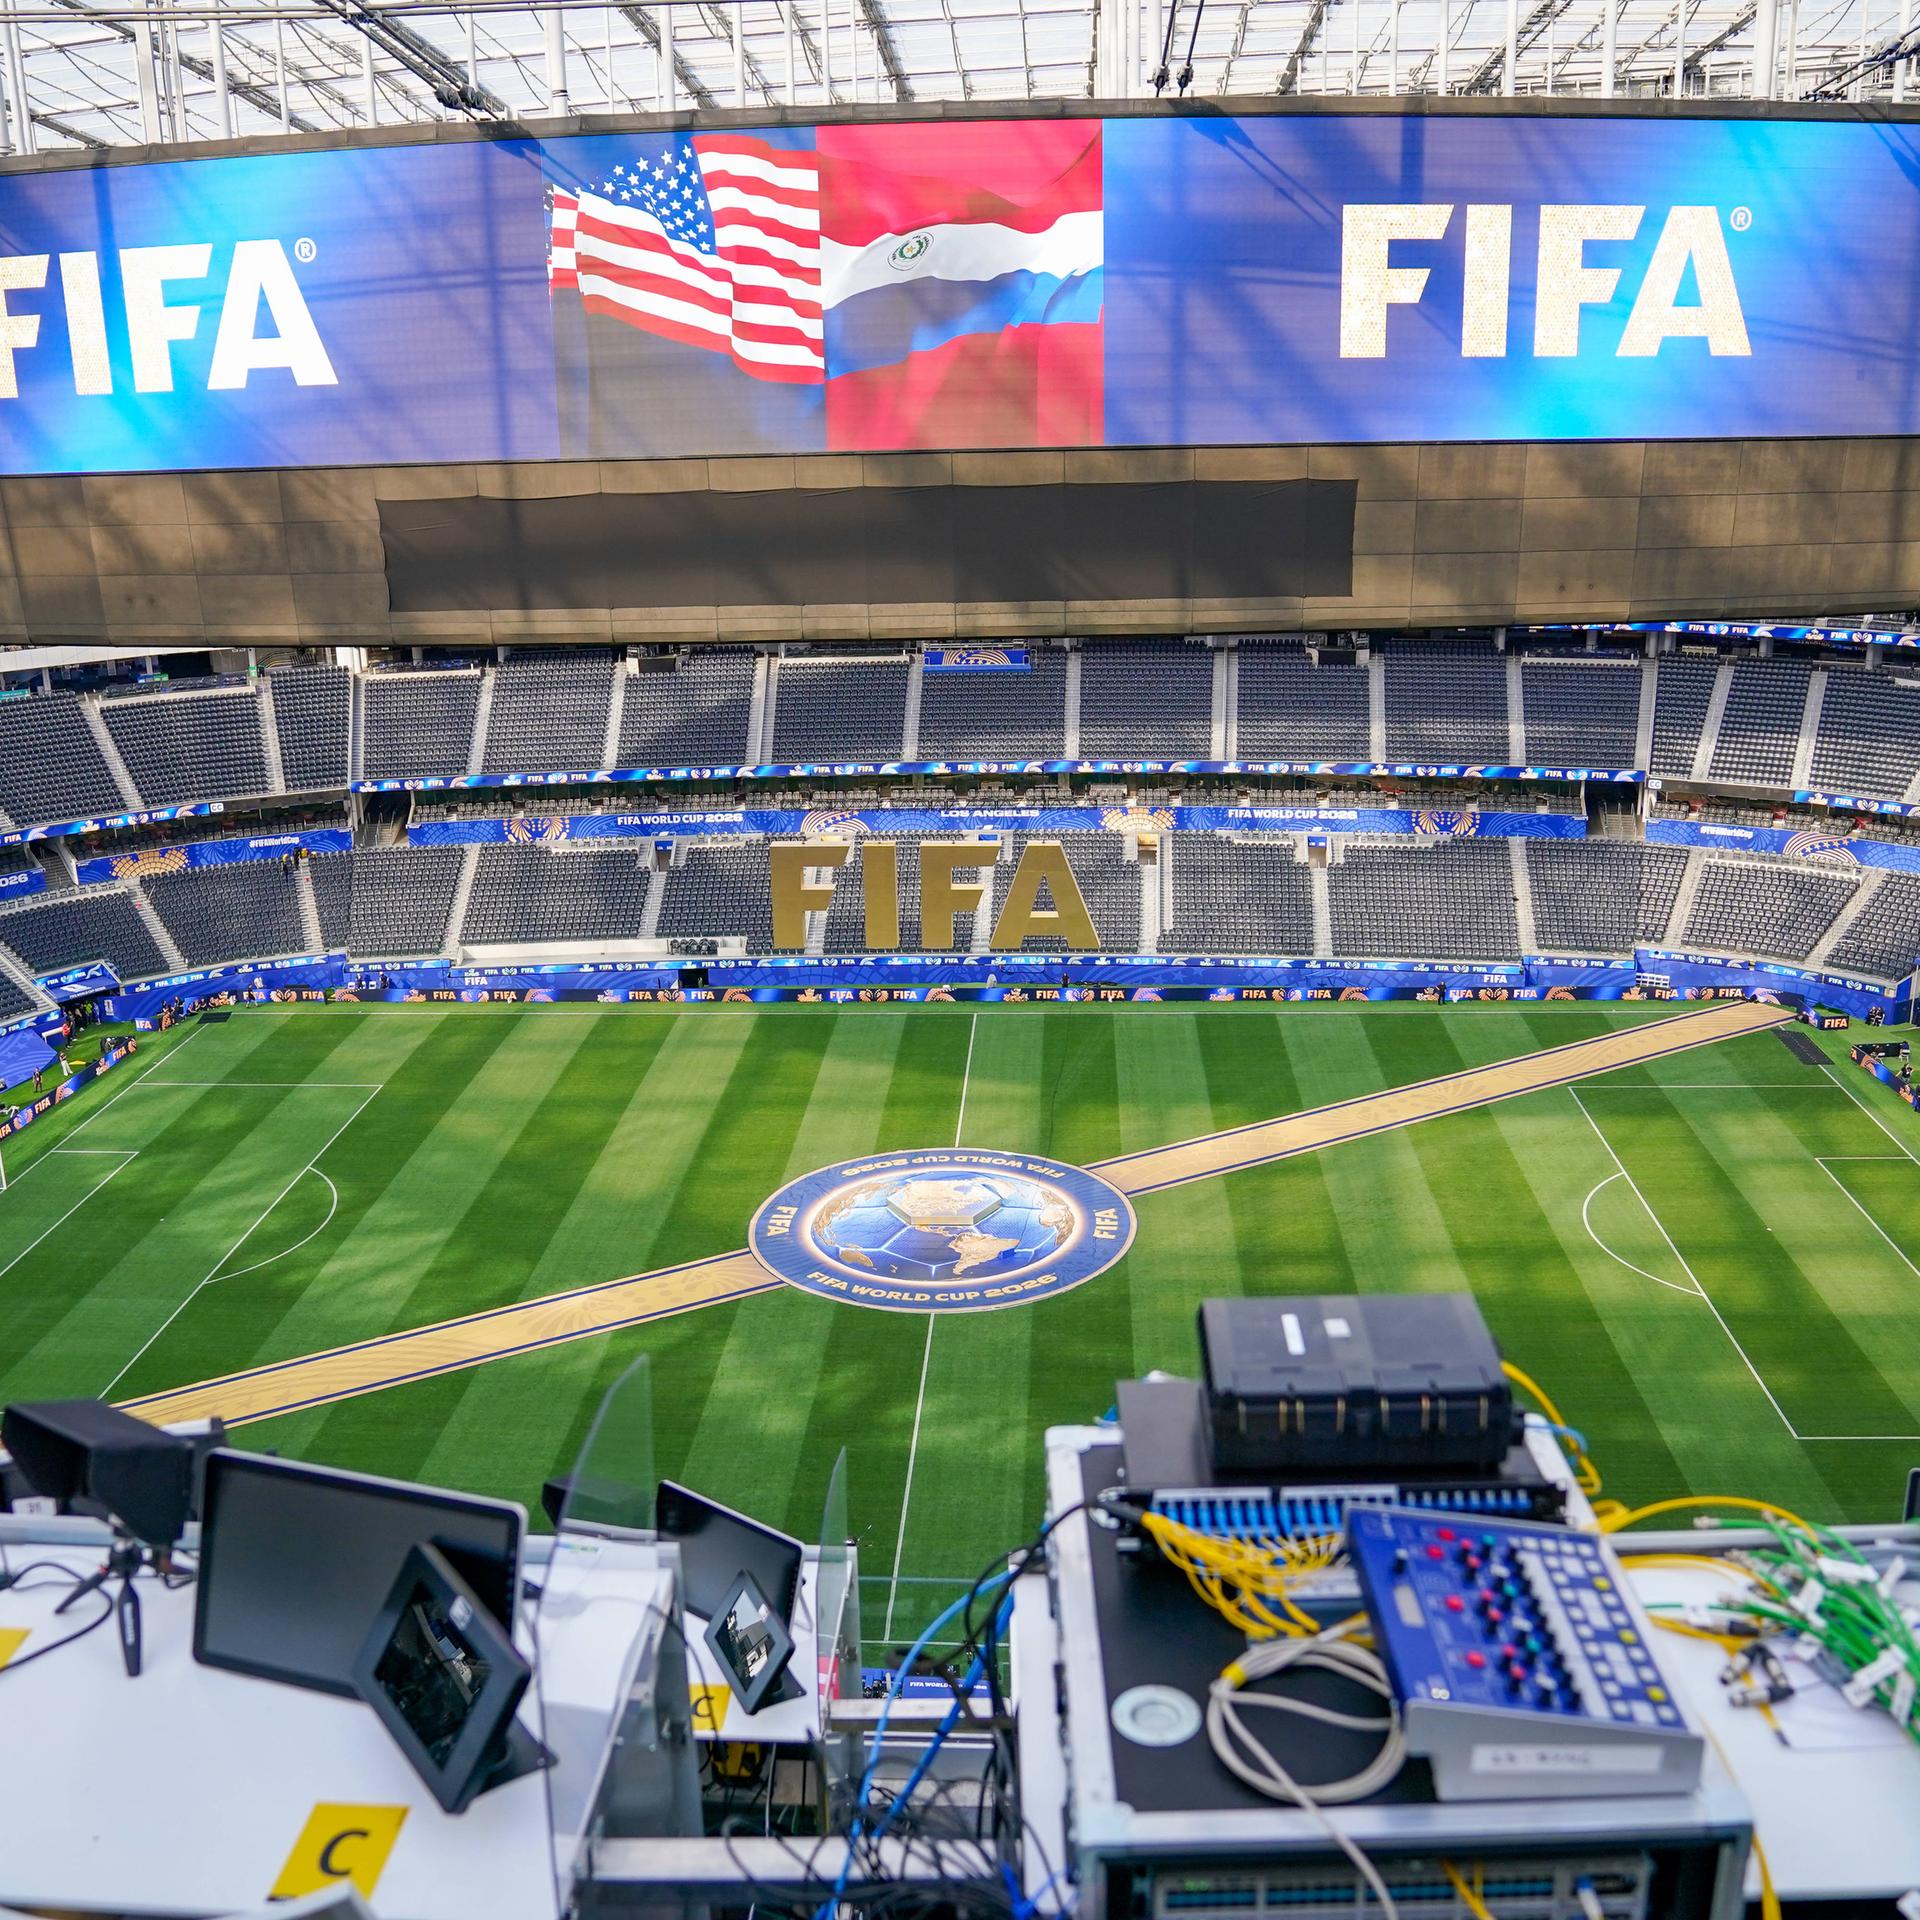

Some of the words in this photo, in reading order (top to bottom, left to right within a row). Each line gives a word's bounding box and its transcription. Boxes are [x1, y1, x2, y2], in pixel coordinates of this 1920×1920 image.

[1876, 635, 1892, 643] FIFA
[1545, 770, 1562, 778] FIFA
[1836, 798, 1853, 806] FIFA
[1884, 804, 1902, 813] FIFA
[1228, 809, 1251, 818] FIFA
[1254, 809, 1292, 819] WORLD
[1295, 810, 1317, 819] CUP
[1318, 810, 1358, 820] 2026
[106, 818, 123, 826] FIFA
[618, 815, 640, 825] FIFA
[642, 815, 681, 824] WORLD
[684, 814, 703, 823] CUP
[705, 814, 743, 823] 2026
[1700, 826, 1753, 839] #FIFAWorldCup
[4, 834, 21, 843] FIFA
[250, 837, 300, 848] #FIFAWorldCup
[770, 840, 1102, 949] FIFA
[465, 977, 487, 985] FIFA
[1484, 975, 1507, 983] FIFA
[1719, 989, 1742, 997] FIFA
[1866, 985, 1879, 993] FIFA
[243, 992, 265, 1000] FA
[434, 992, 456, 1000] FIFA
[494, 992, 516, 1000] FIFA
[629, 992, 652, 1000] FIFA
[691, 992, 714, 1000] FIFA
[830, 991, 853, 999] FIFA
[893, 991, 917, 999] FIFA
[1036, 991, 1059, 999] FIFA
[1101, 991, 1124, 999] FIFA
[1243, 990, 1266, 998] FIFA
[1307, 990, 1331, 998] FIFA
[1450, 990, 1473, 998] FIFA
[1514, 990, 1537, 998] FIFA
[1655, 989, 1678, 999] FIFA
[1825, 1018, 1848, 1028] FIFA
[9, 1024, 19, 1032] FIFA
[113, 1047, 126, 1061] FIFA
[35, 1098, 50, 1114] FIFA
[912, 1155, 950, 1163] CUP
[954, 1155, 1024, 1168] WORLD
[841, 1158, 909, 1177] 2026
[1027, 1163, 1066, 1178] FIFA
[768, 1206, 799, 1236] FIFA
[1093, 1208, 1118, 1239] FIFA
[806, 1271, 848, 1290] FIFA
[851, 1284, 931, 1302] WORLD
[935, 1291, 980, 1302] CUP
[983, 1273, 1058, 1299] 2026
[319, 1829, 370, 1876] C
